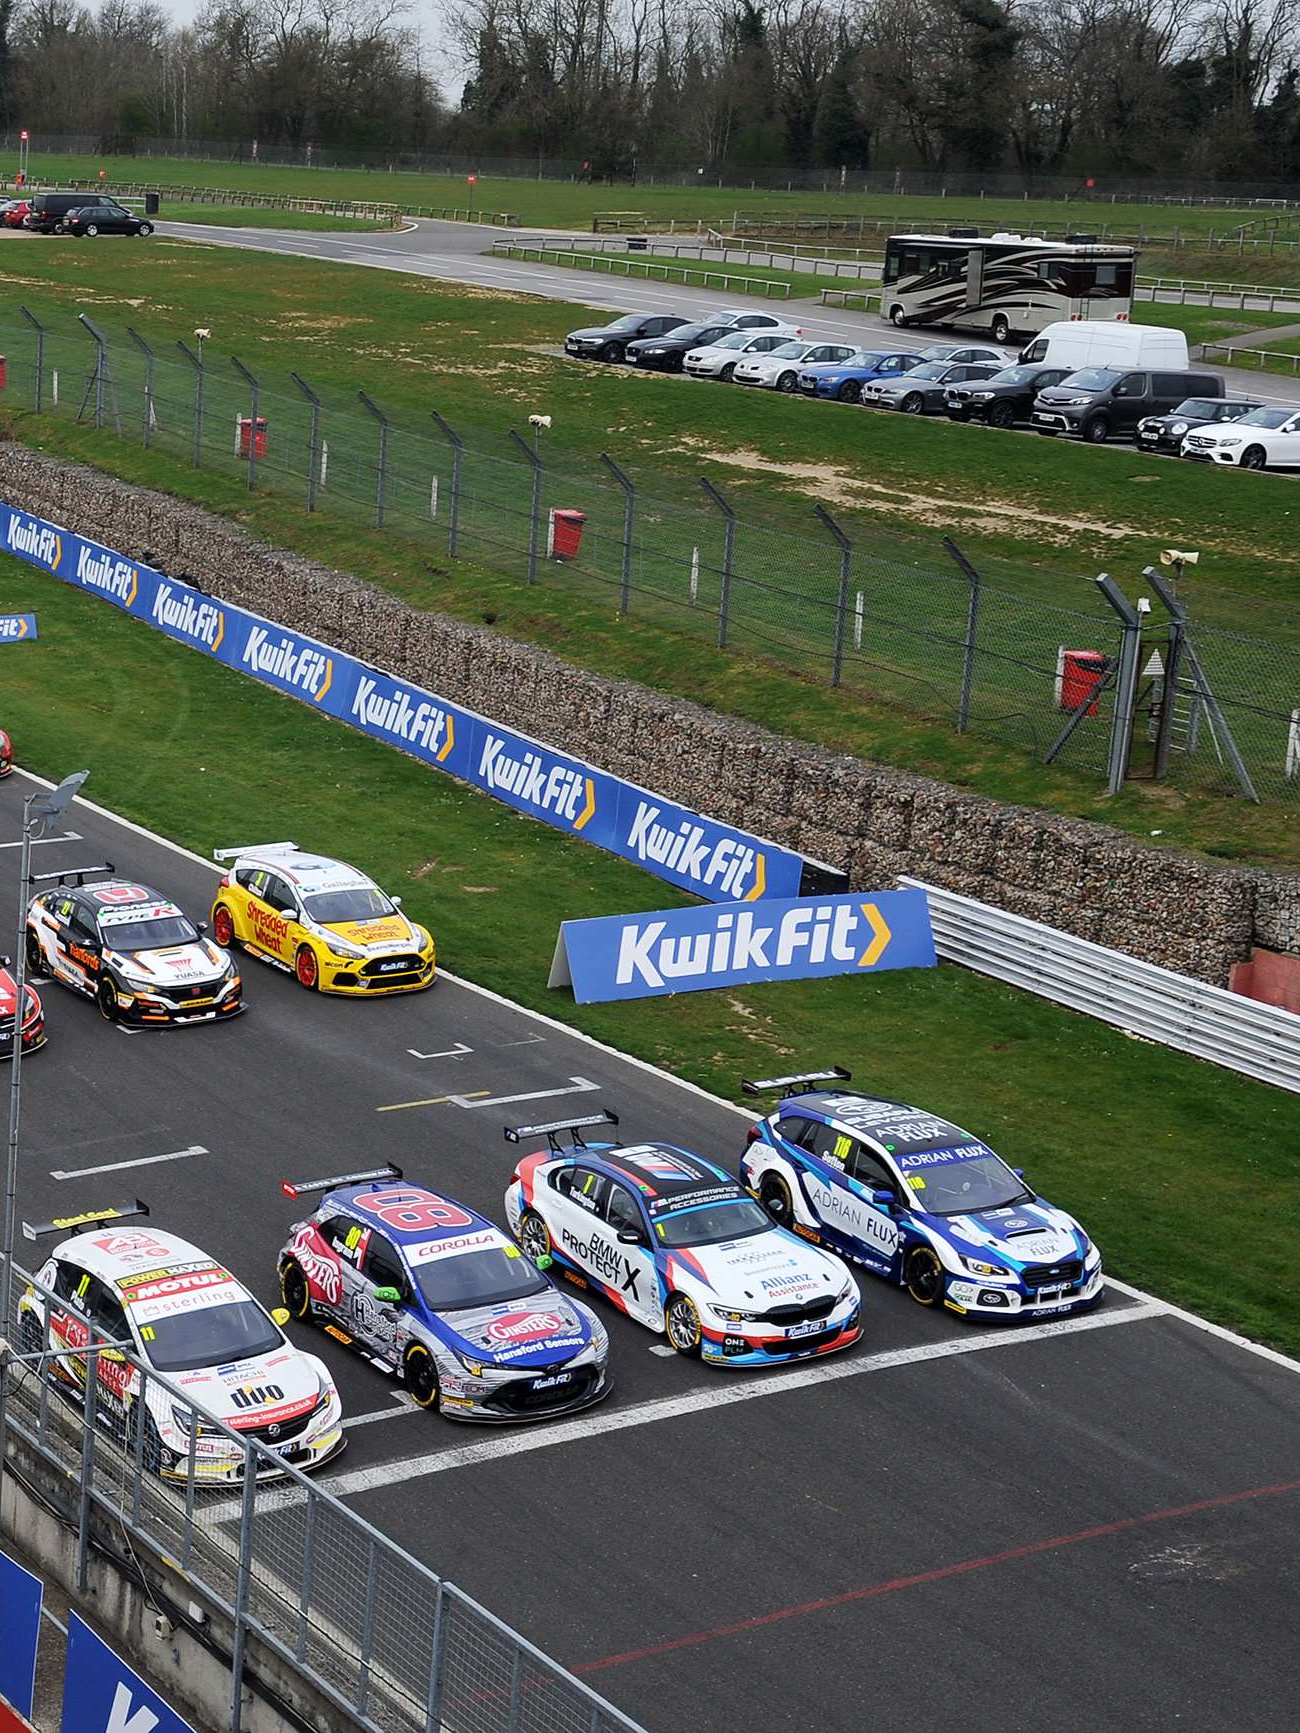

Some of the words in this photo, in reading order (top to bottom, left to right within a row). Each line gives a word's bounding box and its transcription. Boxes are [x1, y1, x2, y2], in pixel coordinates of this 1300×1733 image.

[876, 1120, 949, 1138] ADRIAN
[900, 1128, 948, 1143] FLUX
[901, 1150, 954, 1168] ADRIAN
[955, 1144, 988, 1159] FLUX
[667, 1186, 740, 1203] PERFORMANCE
[812, 1188, 862, 1226] ADRIAN
[866, 1217, 897, 1249] FLUX
[418, 1234, 495, 1257] COROLLA
[562, 1227, 621, 1284] PROTECT
[589, 1232, 622, 1269] BMW
[621, 1258, 642, 1302] X
[78, 1274, 90, 1297] 11
[119, 1269, 169, 1289] POWER
[137, 1274, 224, 1300] MOTUL
[760, 1272, 813, 1290] Allianz
[768, 1282, 820, 1298] Assistance
[163, 1290, 236, 1313] sterling
[140, 1326, 156, 1341] 11
[493, 1342, 544, 1363] Hansford
[545, 1337, 585, 1349] Sensors
[230, 1384, 285, 1409] duo
